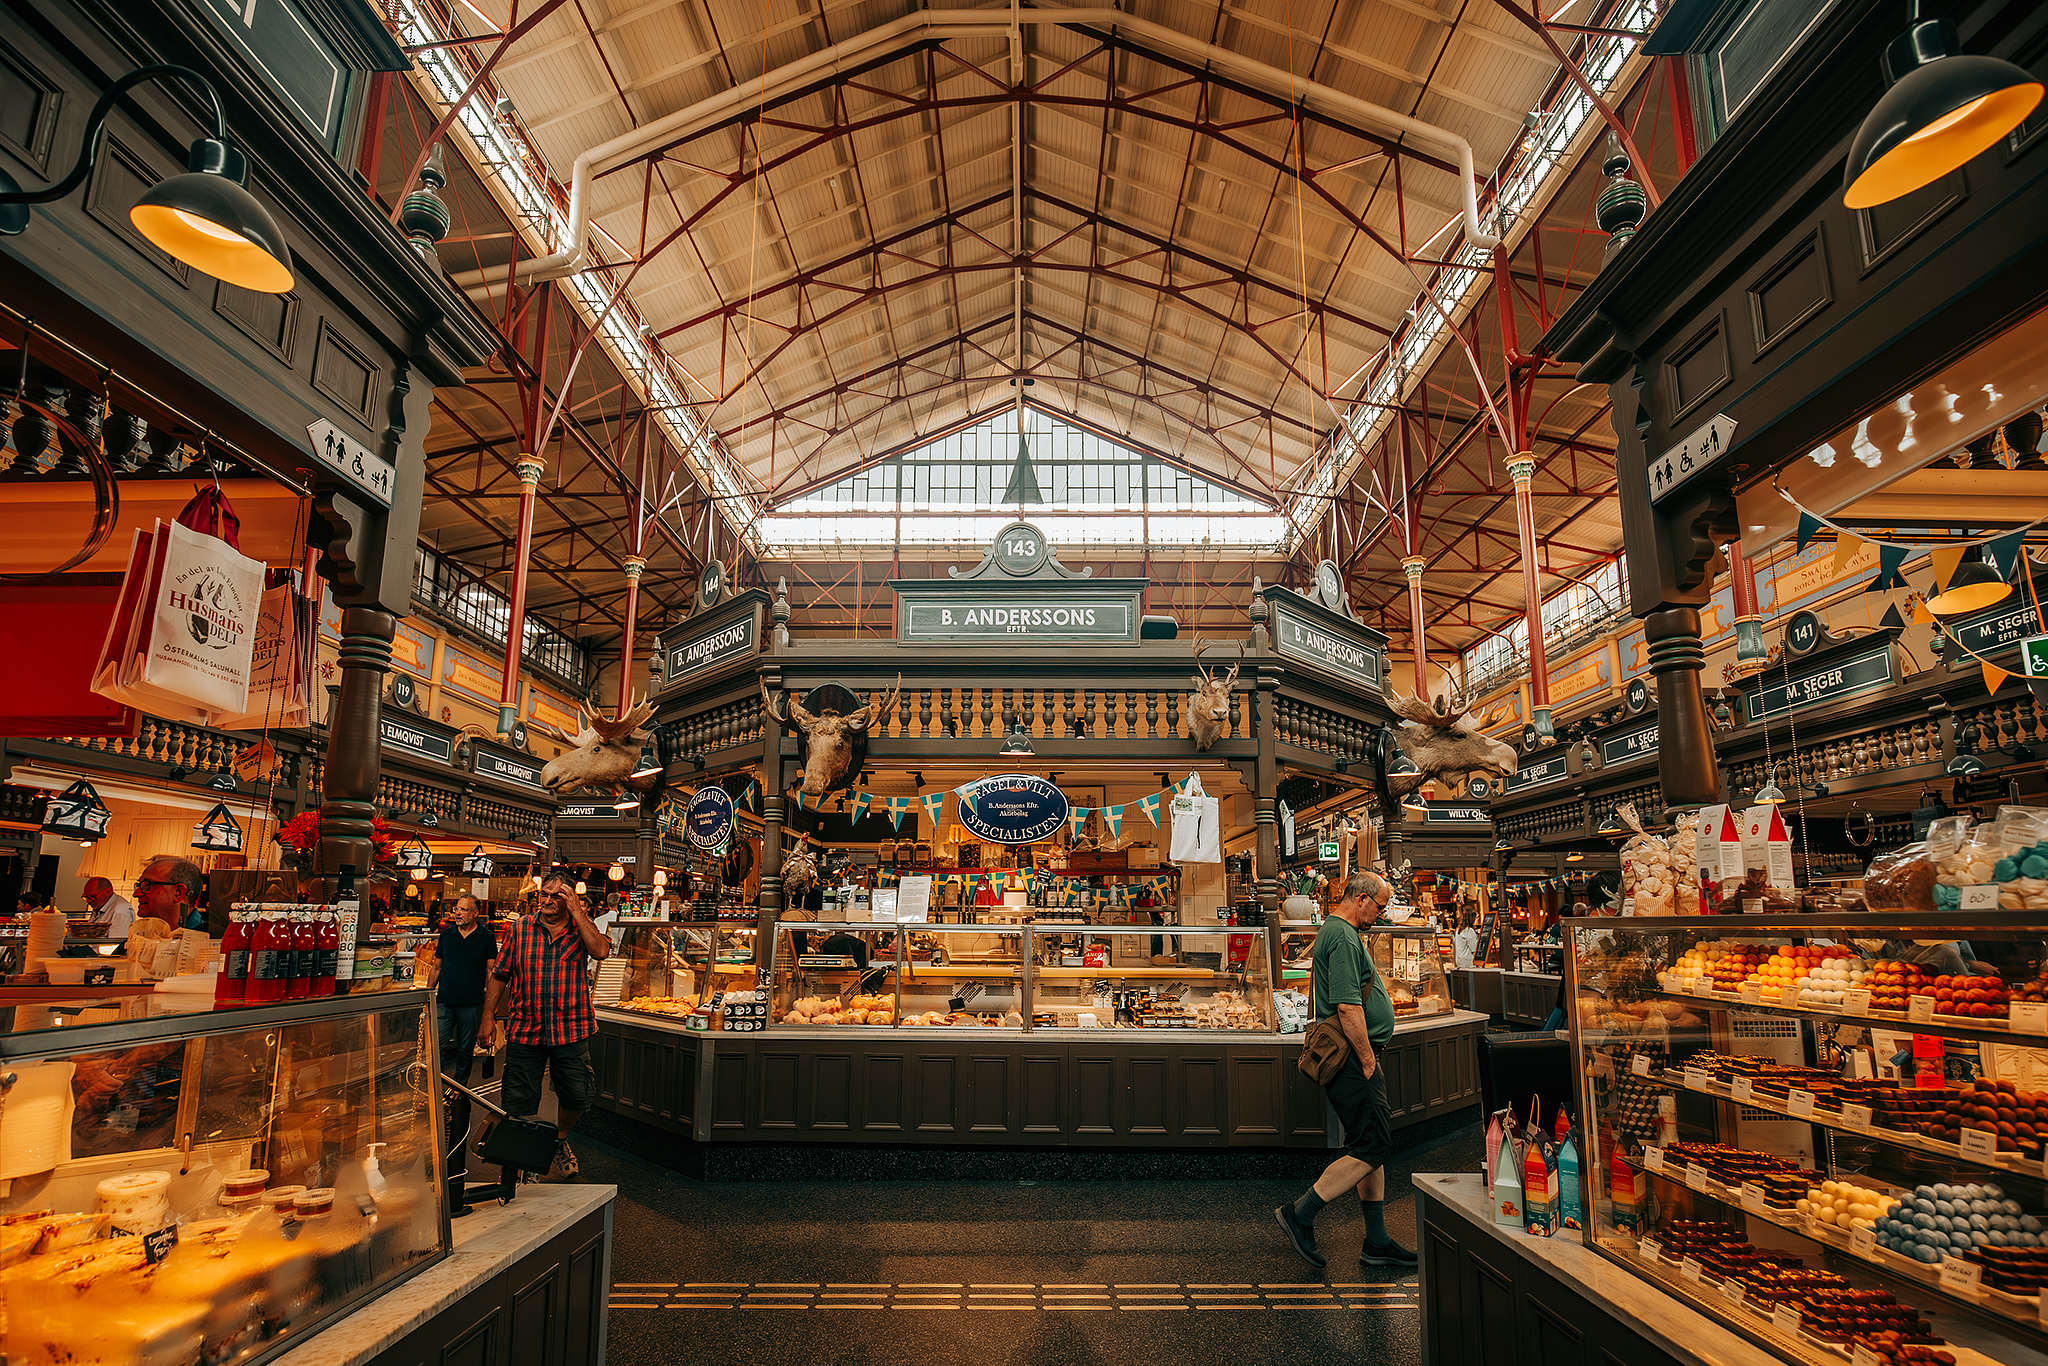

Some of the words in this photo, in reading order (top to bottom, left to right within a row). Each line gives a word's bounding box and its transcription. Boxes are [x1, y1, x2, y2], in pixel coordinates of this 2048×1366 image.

[1005, 540, 1036, 557] 143
[175, 573, 188, 584] En
[188, 565, 203, 577] del
[704, 575, 719, 595] 144
[1322, 576, 1338, 596] 158
[168, 589, 245, 635] Husmans
[941, 609, 958, 626] B.
[964, 609, 1096, 626] ANDERSSONS
[1794, 623, 1814, 642] 141
[1980, 625, 1995, 638] M.
[1997, 610, 2038, 631] SEGER
[209, 623, 238, 646] DELI
[1998, 630, 2022, 642] EFTR.
[677, 652, 685, 667] B.
[686, 624, 745, 663] ANDERSSONS
[1294, 626, 1304, 644] B.
[1306, 631, 1364, 668] ANDERSSONS
[163, 644, 209, 666] ÖSTERMALMS
[210, 661, 241, 677] SALUHALL
[397, 682, 410, 697] 119
[1786, 684, 1801, 700] M.
[1803, 670, 1844, 694] SEGER
[1630, 688, 1645, 703] 140
[387, 726, 424, 747] ELMQVIST
[514, 730, 524, 741] 120
[1627, 737, 1638, 750] M.
[1638, 729, 1659, 746] SEGE
[494, 760, 507, 774] LISA
[507, 765, 533, 781] ELMQVIST
[1530, 764, 1549, 778] SEGER
[1472, 783, 1485, 792] 137
[1448, 809, 1470, 818] WILLY
[688, 818, 729, 846] SPECIALISTEN
[966, 812, 1061, 840] SPECIALISTEN
